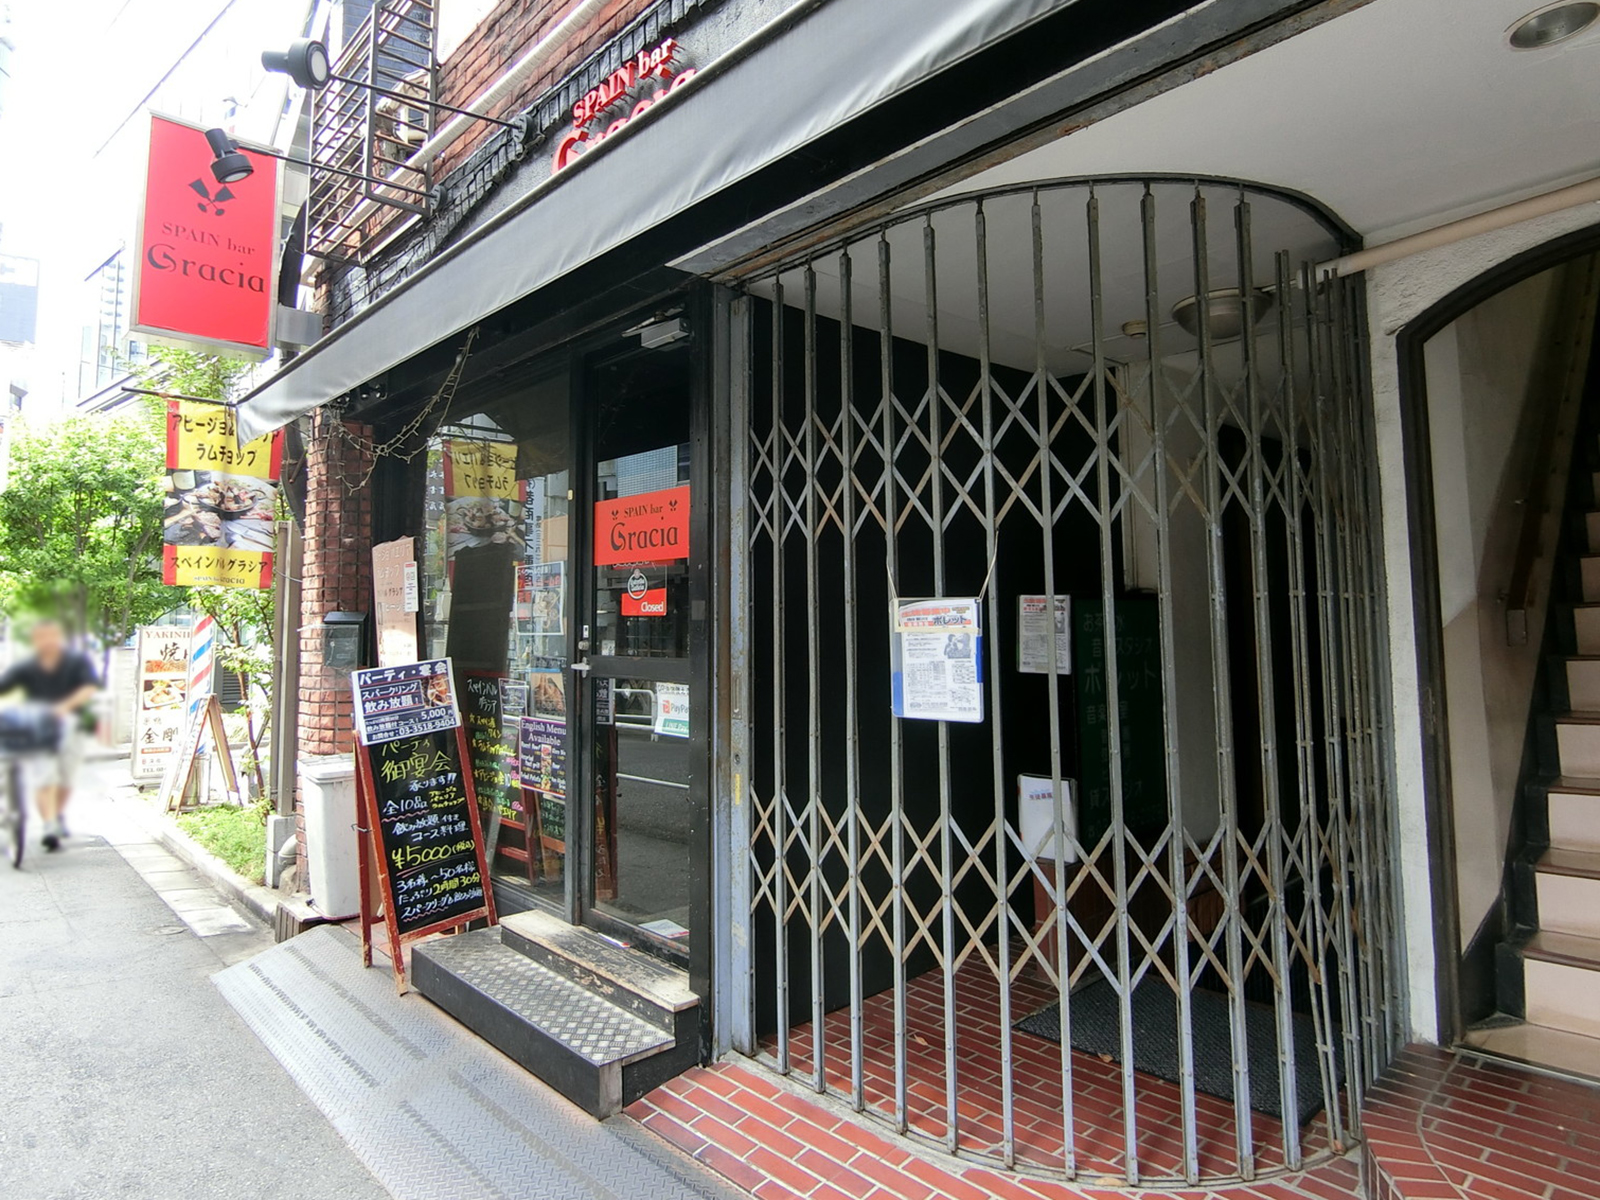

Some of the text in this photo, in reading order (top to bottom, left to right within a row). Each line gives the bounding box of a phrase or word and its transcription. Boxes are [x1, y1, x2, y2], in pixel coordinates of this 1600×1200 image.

[572, 61, 636, 128] SPAIN
[637, 37, 678, 80] bar
[161, 222, 256, 255] SPAIN bar
[147, 243, 265, 293] Gracia
[196, 443, 257, 467] ラムチョップ
[624, 504, 663, 518] SPAIN bar
[610, 516, 678, 551] Gracia
[641, 601, 664, 613] Closed
[521, 719, 567, 737] English Menu
[382, 738, 431, 756] パーティ
[528, 732, 562, 748] Available
[381, 751, 451, 783] 御宴会
[383, 796, 429, 815] 全10品
